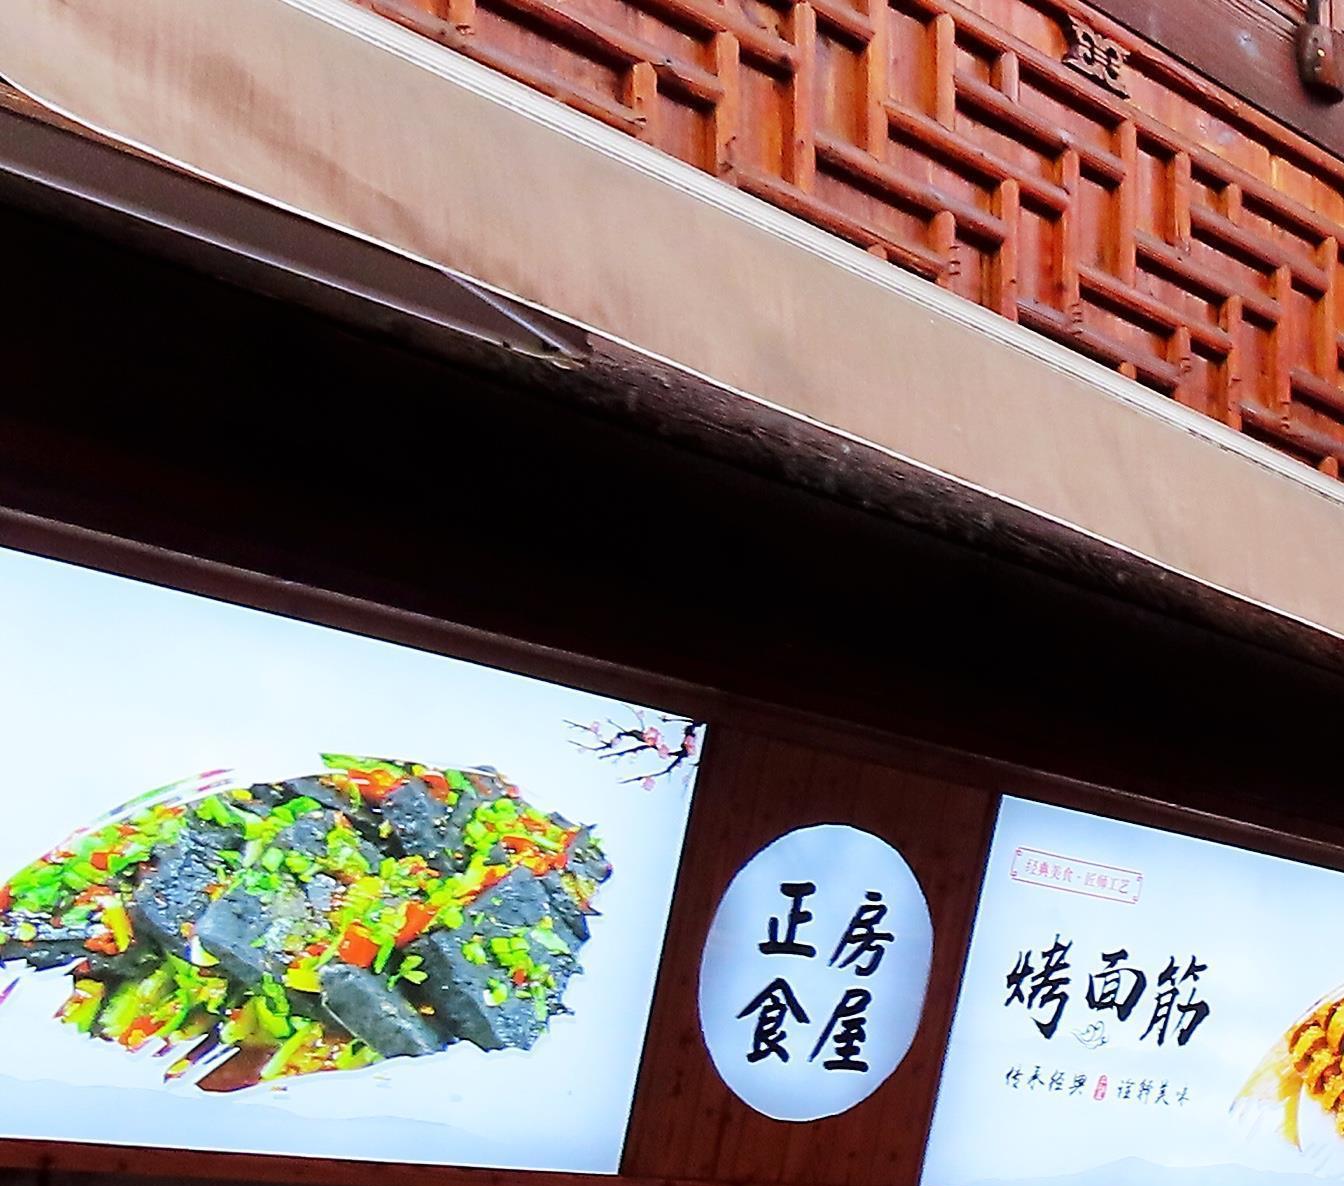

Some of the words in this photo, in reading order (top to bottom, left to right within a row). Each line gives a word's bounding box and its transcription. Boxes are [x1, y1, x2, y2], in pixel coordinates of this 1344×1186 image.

[758, 882, 895, 976] 正房
[736, 978, 872, 1073] 食屋
[1004, 933, 1210, 1046] 烤面筋
